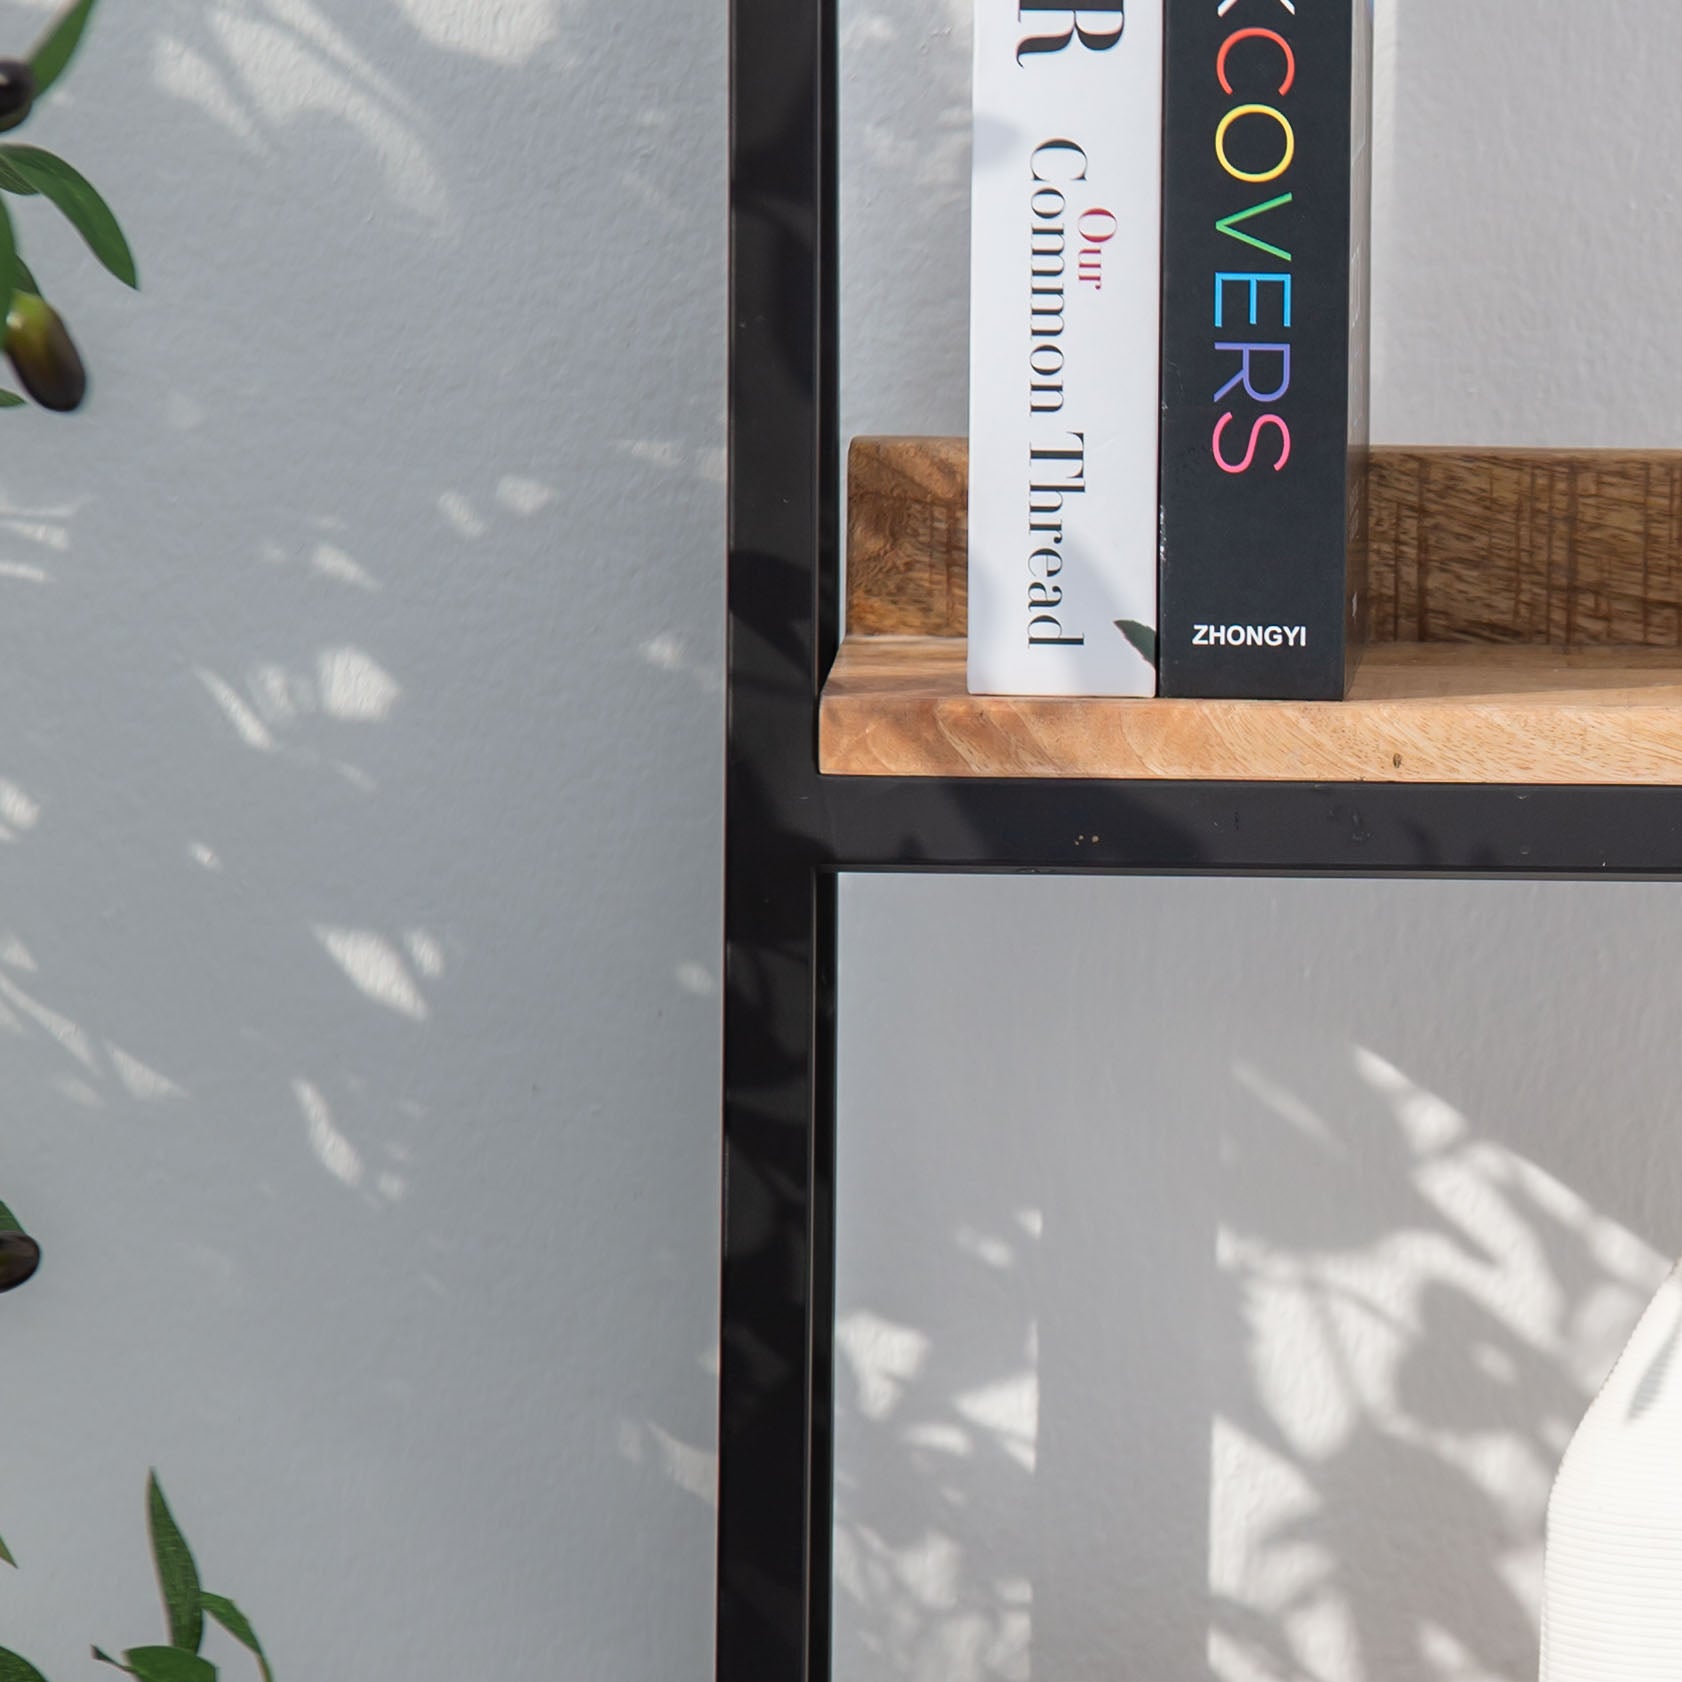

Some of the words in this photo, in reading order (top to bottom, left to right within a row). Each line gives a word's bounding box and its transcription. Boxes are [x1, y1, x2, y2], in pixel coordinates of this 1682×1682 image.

[1030, 138, 1088, 417] Common
[1077, 207, 1118, 291] Our
[1211, 0, 1296, 473] COVERS
[1027, 432, 1086, 650] Thread
[1192, 624, 1307, 647] ZHONGYI
